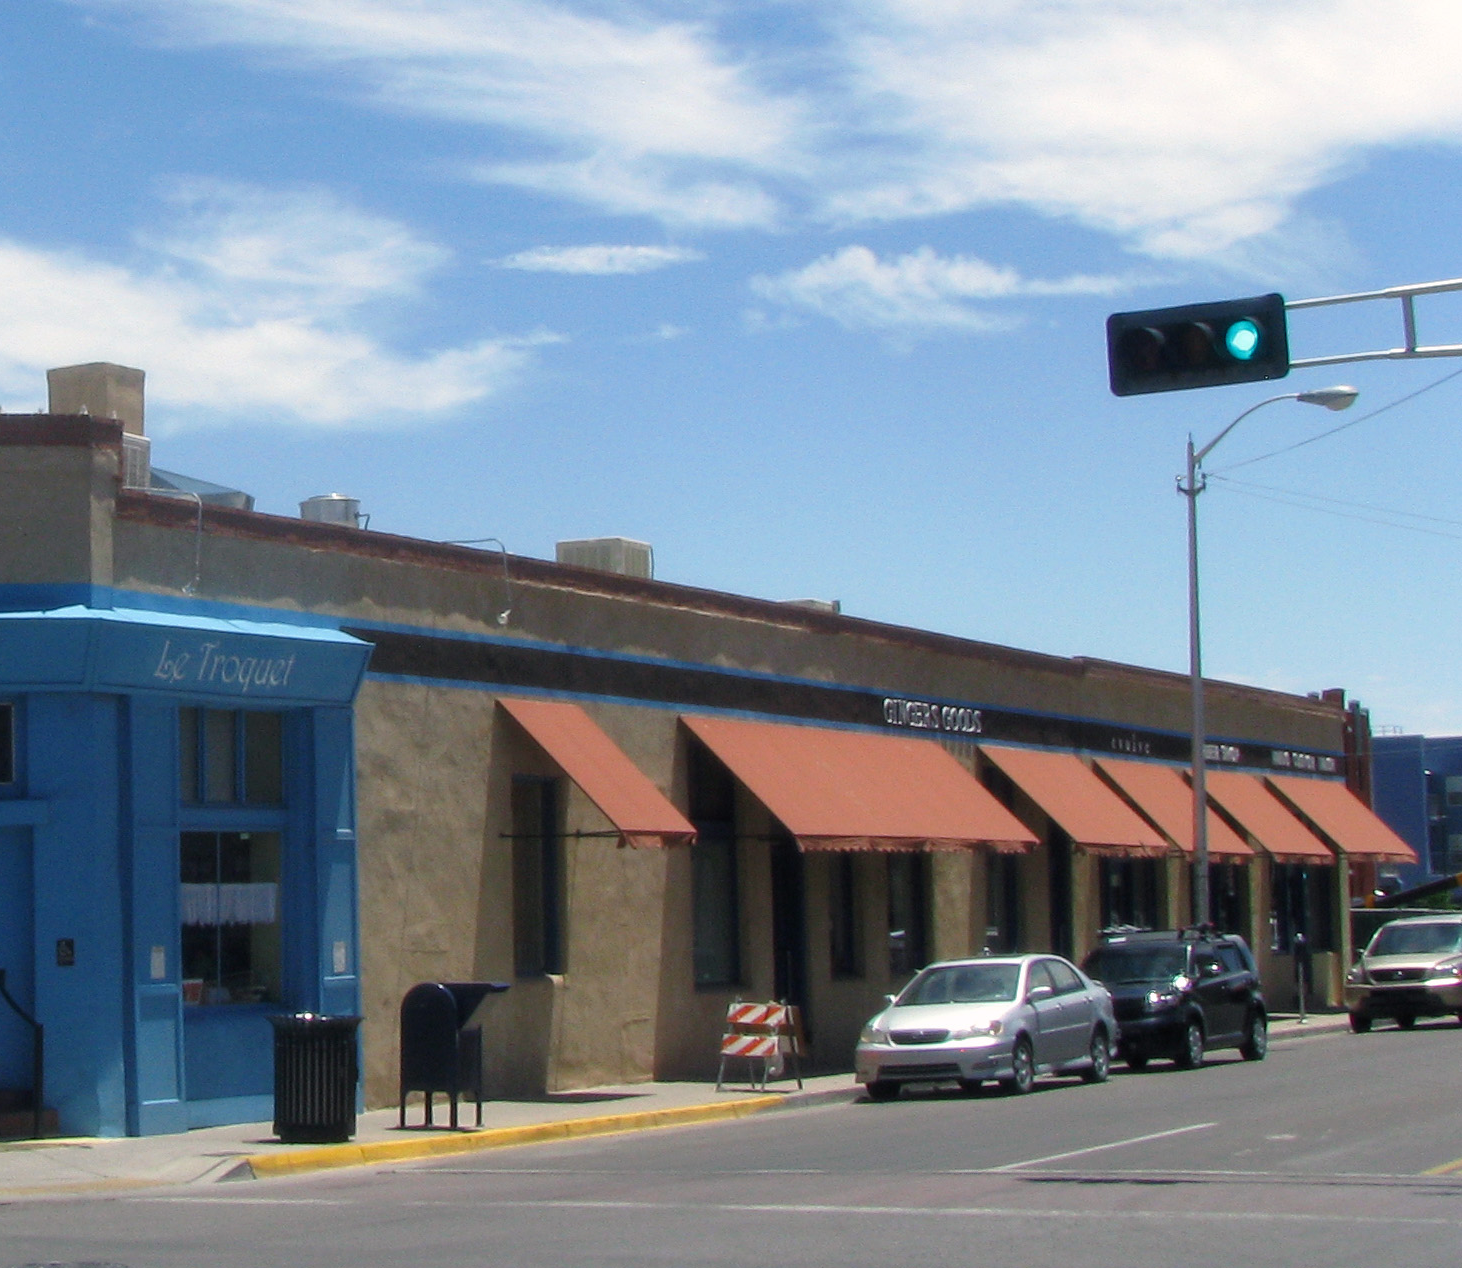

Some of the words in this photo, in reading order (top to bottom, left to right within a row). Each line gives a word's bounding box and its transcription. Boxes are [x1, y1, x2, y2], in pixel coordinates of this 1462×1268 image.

[154, 640, 191, 683] Le
[198, 640, 296, 693] Troquet
[942, 705, 982, 733] GOODS
